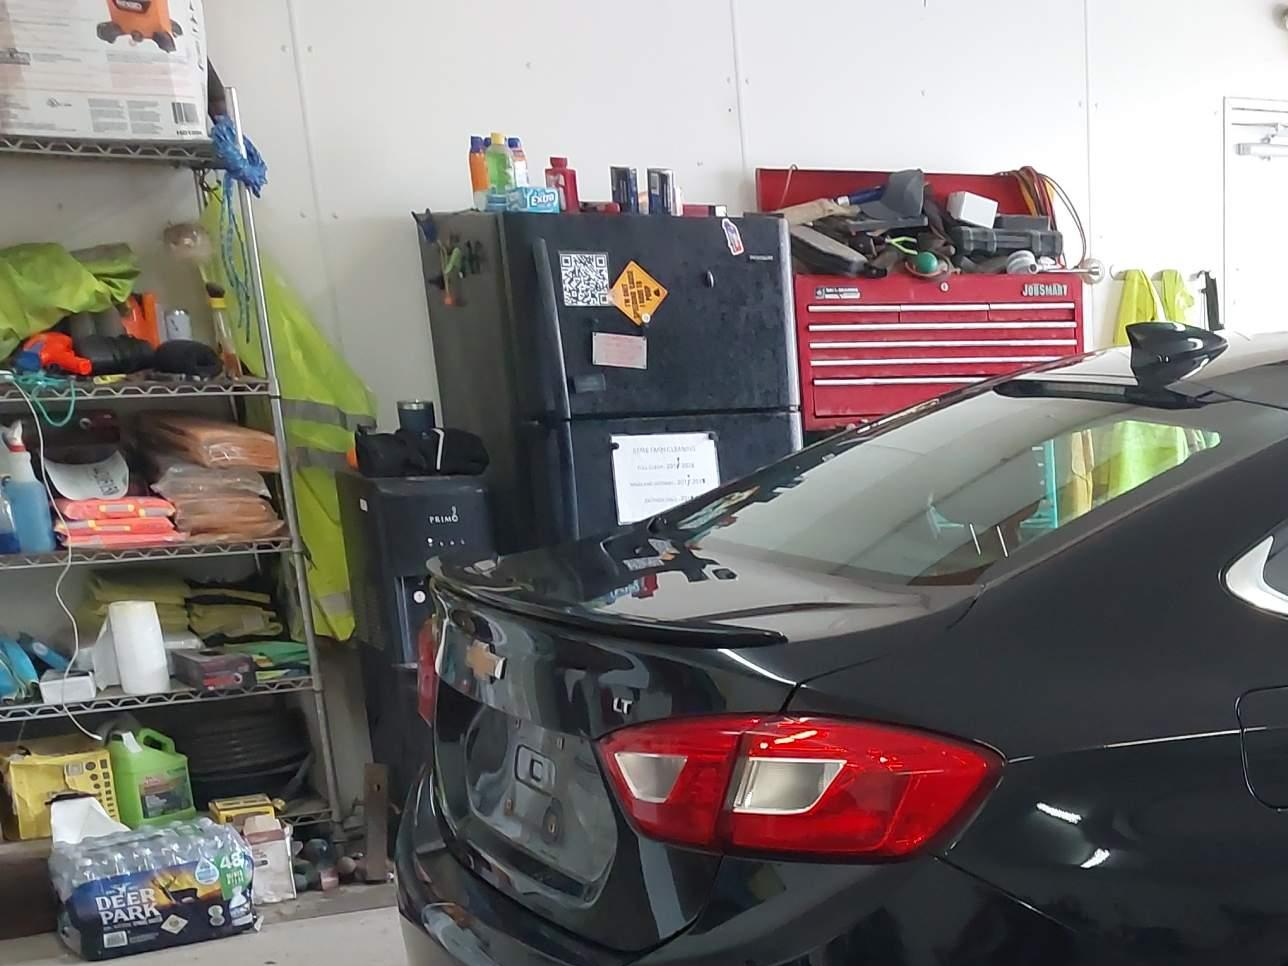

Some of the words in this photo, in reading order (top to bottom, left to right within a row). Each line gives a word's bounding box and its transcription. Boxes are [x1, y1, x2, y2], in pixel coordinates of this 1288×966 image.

[613, 697, 632, 714] LT
[220, 852, 242, 869] 48
[95, 888, 156, 911] DEER
[99, 902, 161, 925] PARK
